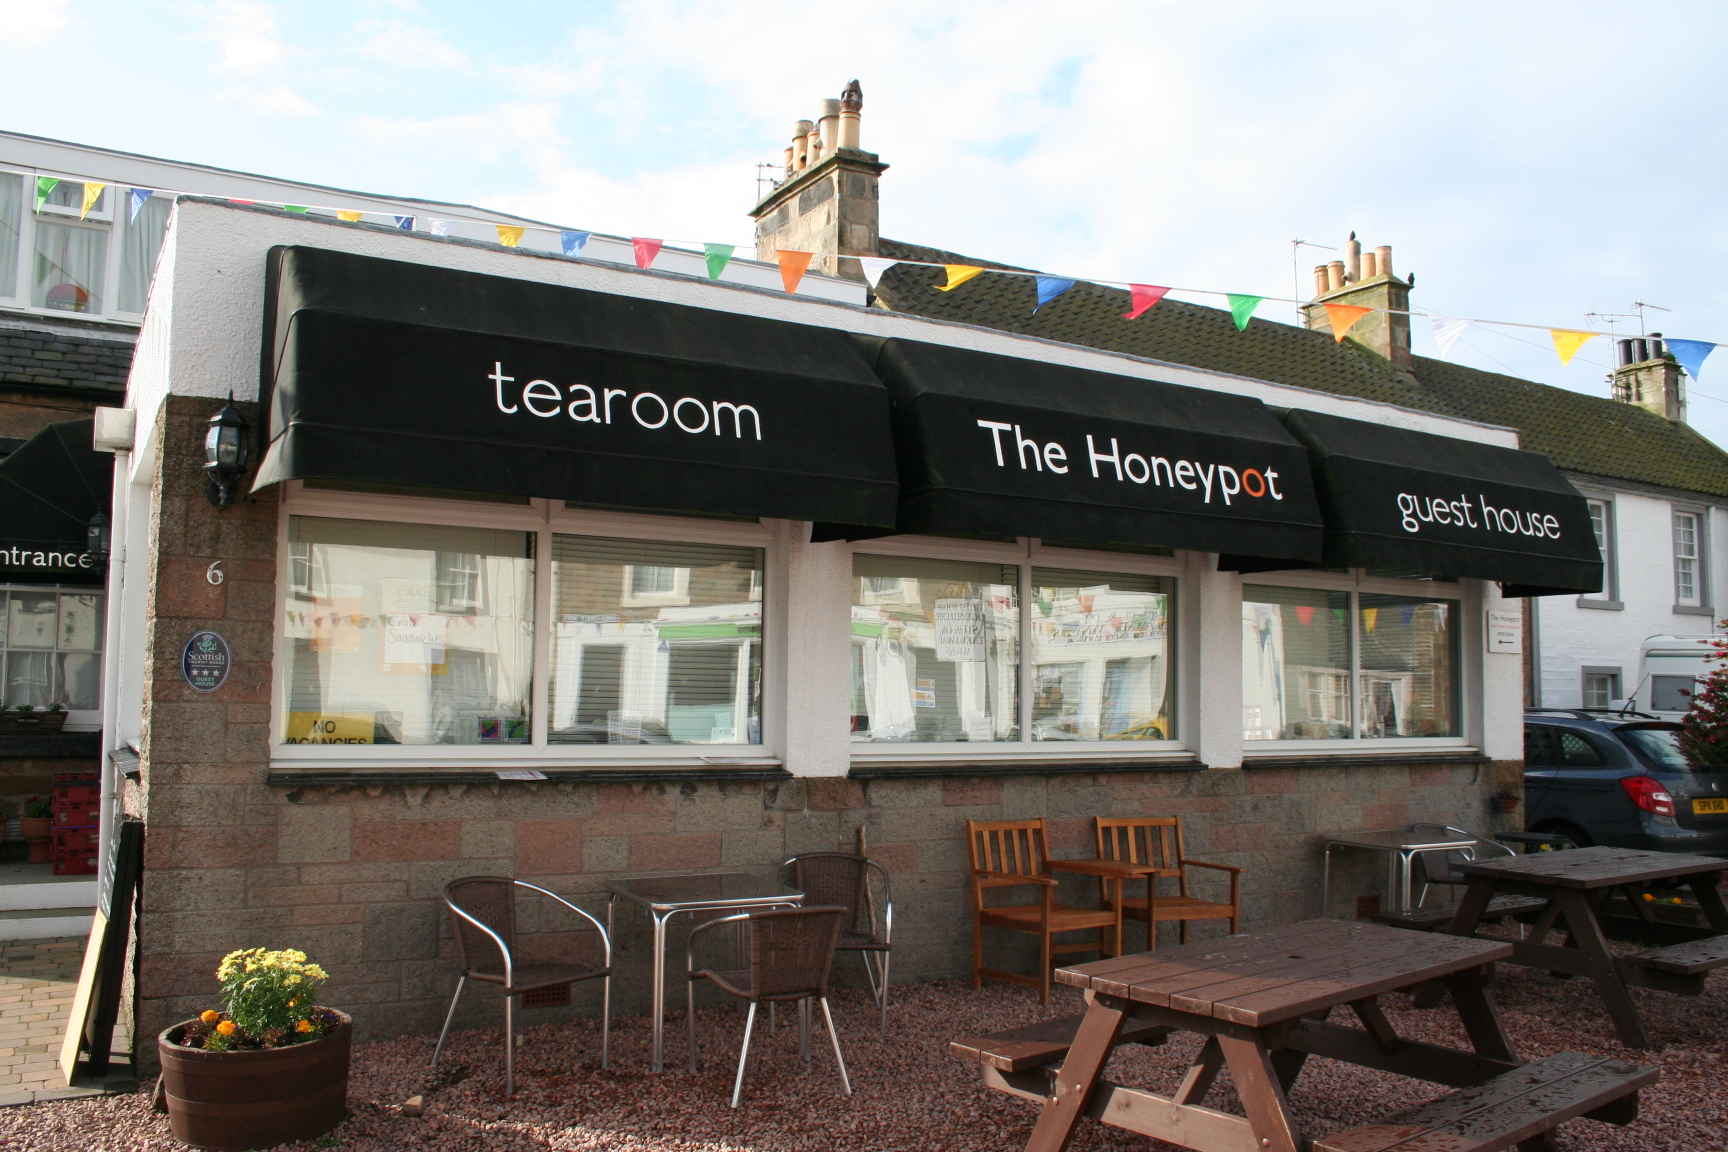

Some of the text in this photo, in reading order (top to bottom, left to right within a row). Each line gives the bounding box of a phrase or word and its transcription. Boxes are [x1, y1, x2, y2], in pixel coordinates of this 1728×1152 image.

[488, 361, 762, 441] tearoom
[976, 419, 1283, 506] The Honeypot
[1397, 492, 1561, 540] guest house
[206, 561, 224, 585] 6
[398, 589, 434, 598] CRAIL
[398, 604, 432, 612] FESTIVAL
[388, 615, 416, 627] Crab
[386, 628, 446, 646] Sandwiches
[188, 651, 225, 661] Scottish
[313, 720, 337, 734] NO
